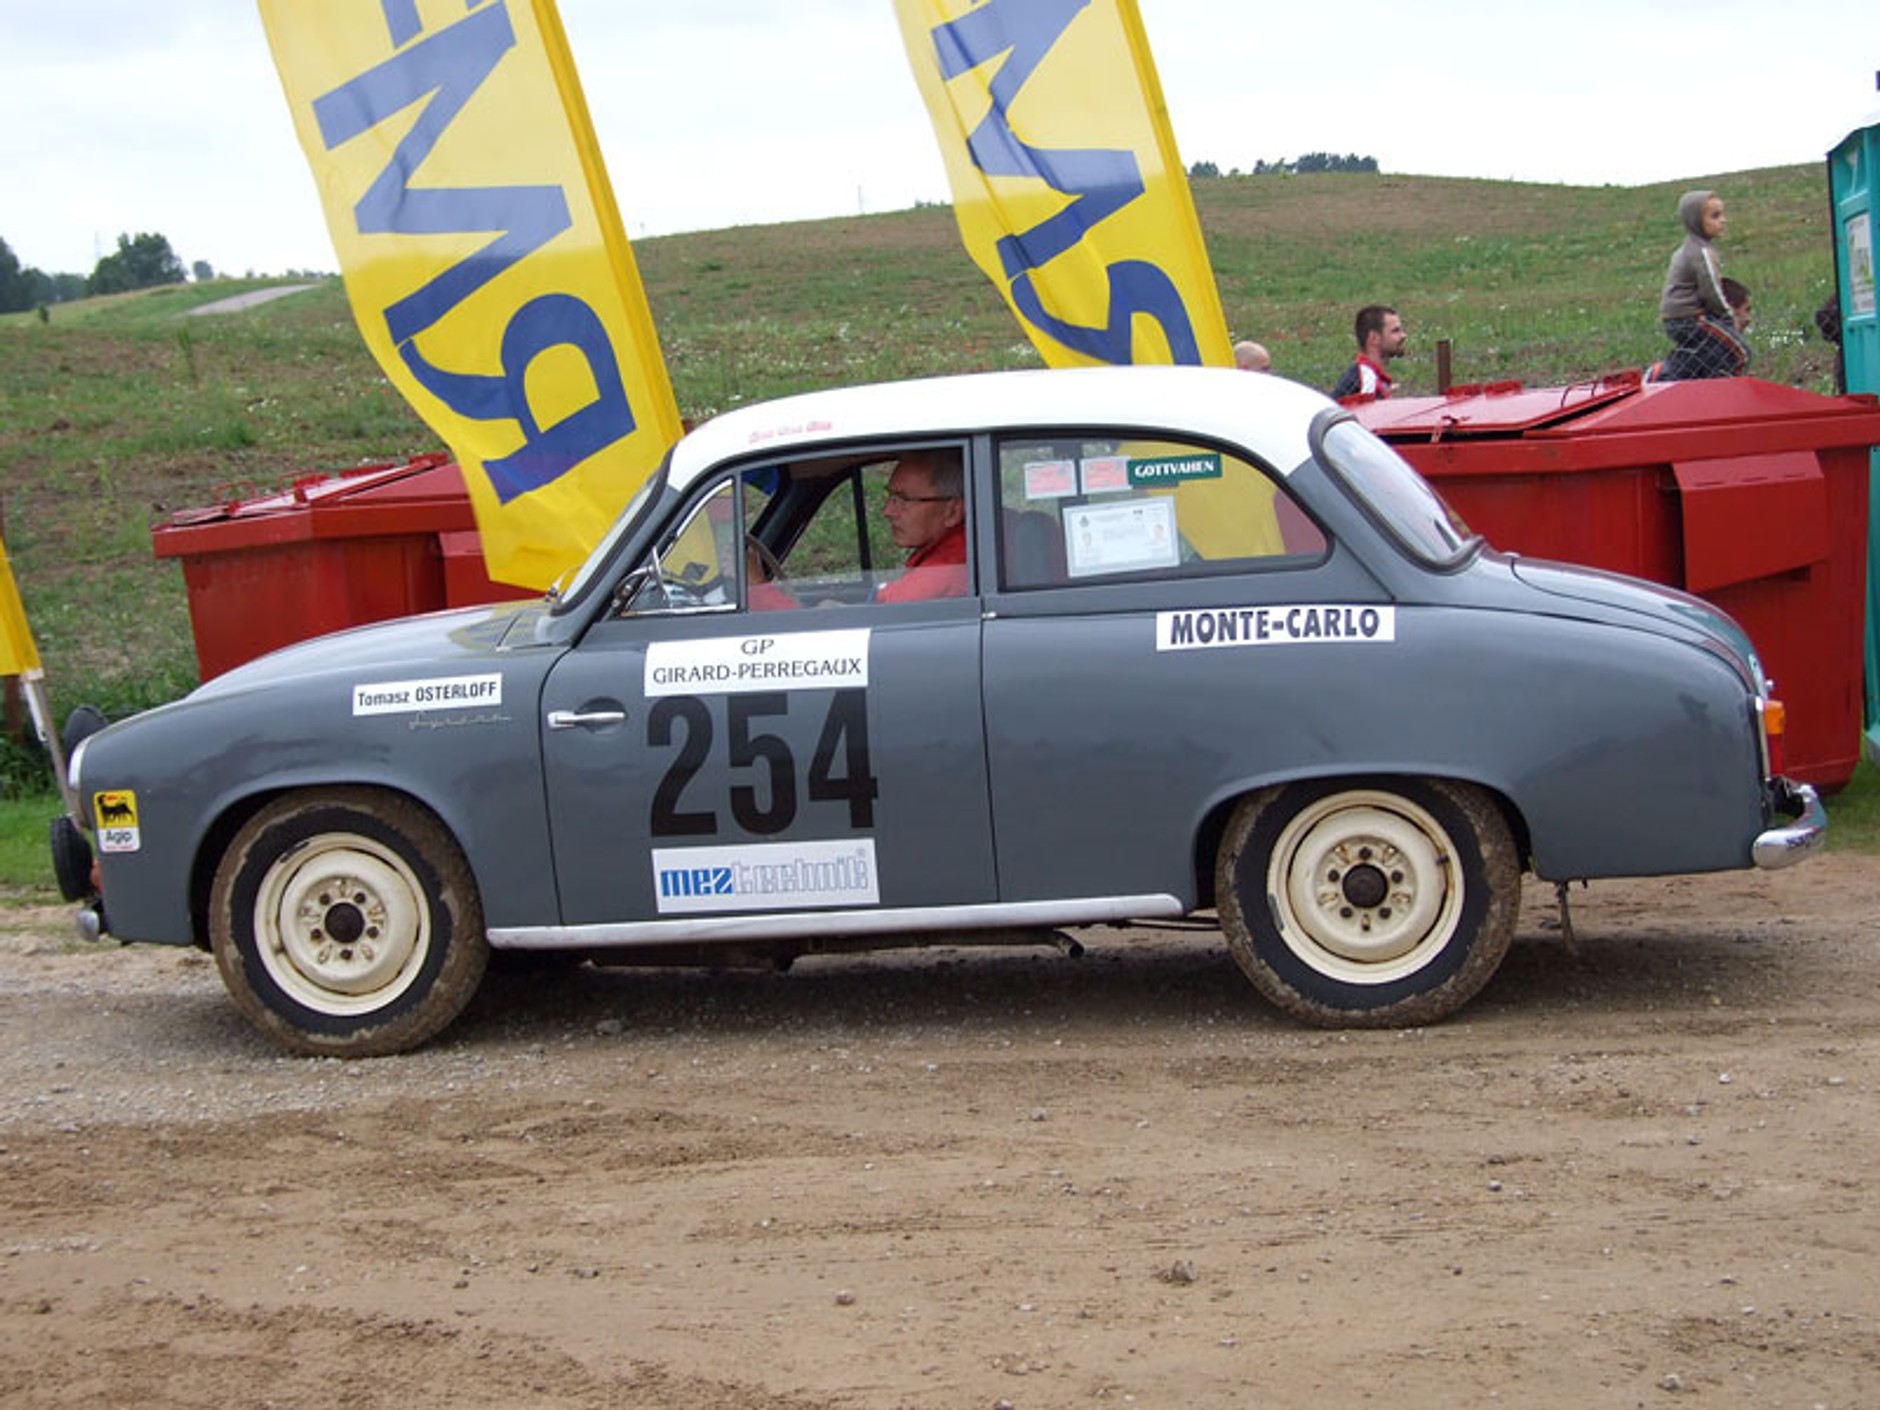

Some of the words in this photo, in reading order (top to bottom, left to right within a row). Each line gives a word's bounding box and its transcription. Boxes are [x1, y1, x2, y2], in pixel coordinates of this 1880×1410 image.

[1171, 608, 1380, 644] MONTE-CARLO
[740, 639, 774, 655] GP
[653, 658, 862, 684] GIRARD-PERREGAUX
[358, 691, 411, 706] Tomasz
[415, 682, 497, 702] OSTERLOFF
[648, 689, 878, 837] 254
[105, 830, 133, 844] Agip
